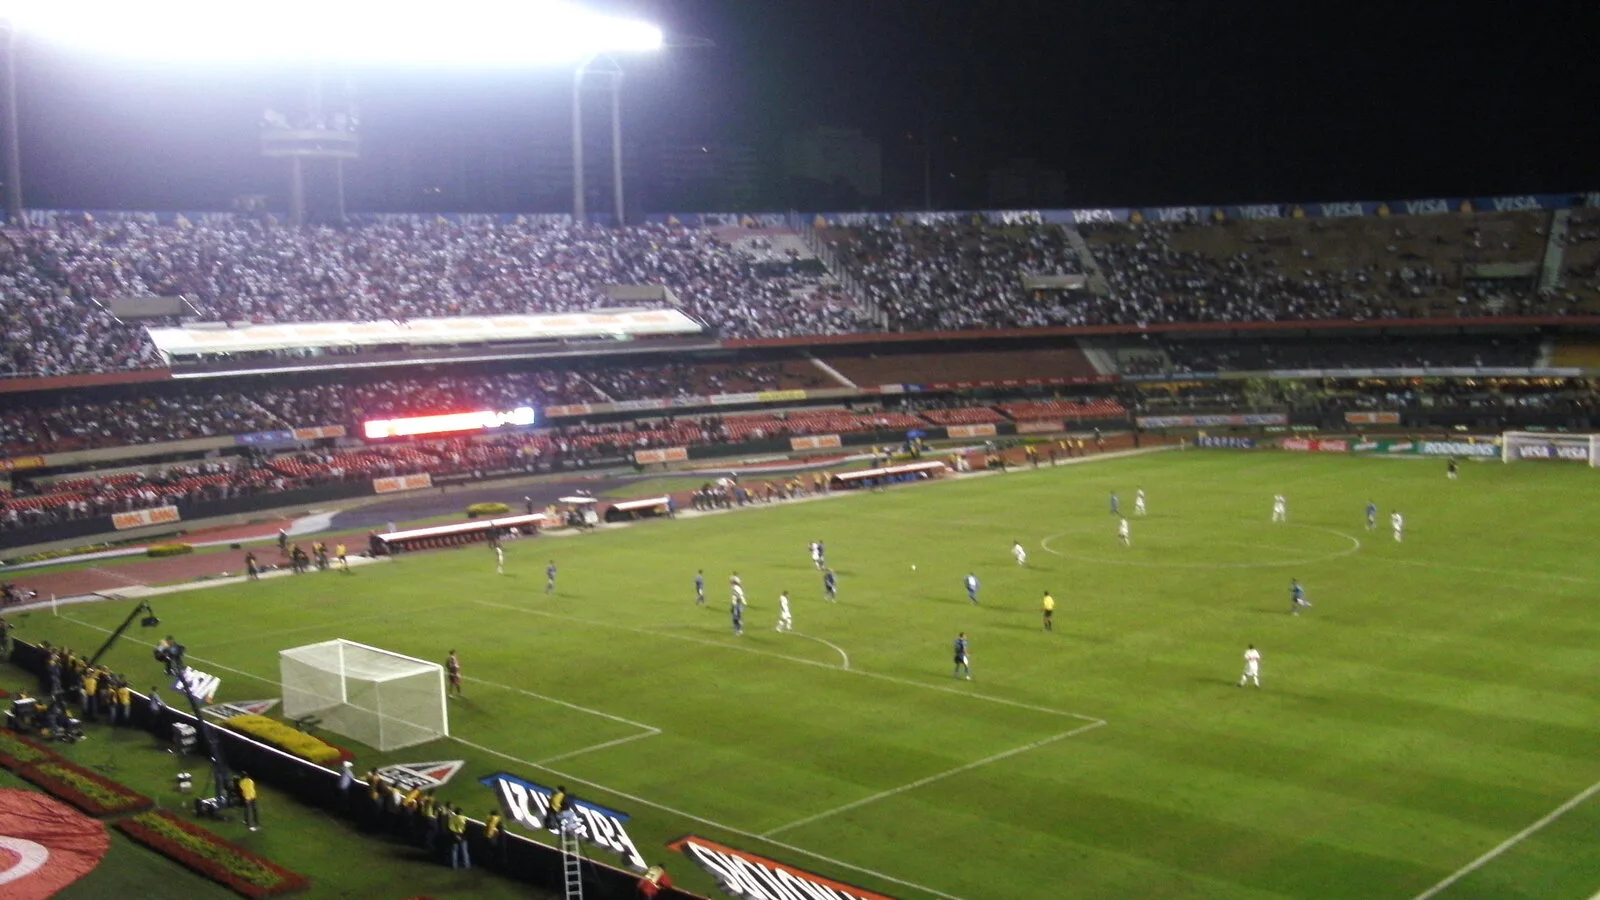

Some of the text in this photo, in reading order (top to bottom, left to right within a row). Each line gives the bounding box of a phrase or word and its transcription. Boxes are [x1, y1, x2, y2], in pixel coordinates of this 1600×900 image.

[1238, 204, 1281, 219] VISA
[1319, 202, 1364, 218] VISA
[1405, 199, 1448, 216] VISA
[1492, 196, 1540, 212] VISA
[1518, 445, 1588, 459] VISA VISA
